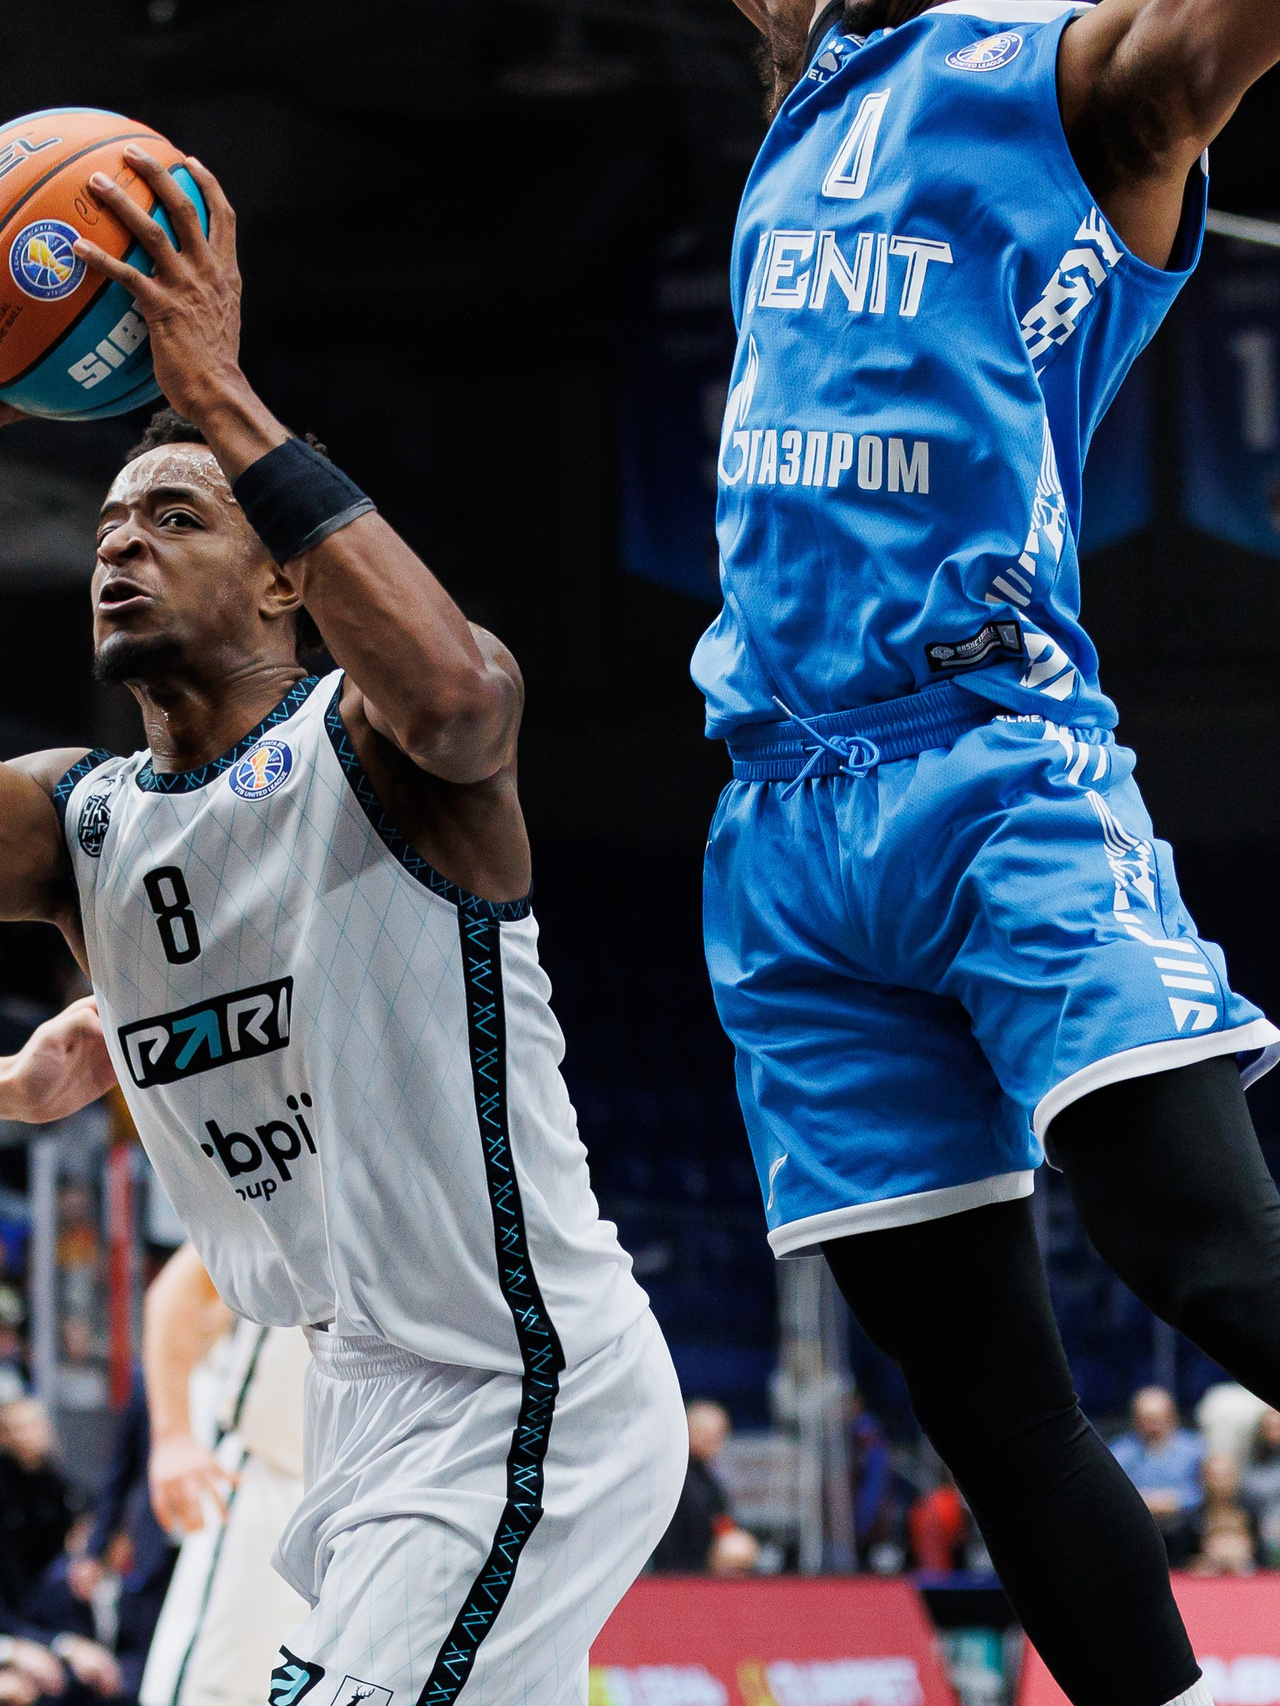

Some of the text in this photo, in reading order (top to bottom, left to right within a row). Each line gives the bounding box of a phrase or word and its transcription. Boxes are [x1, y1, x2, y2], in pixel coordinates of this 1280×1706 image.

[822, 88, 891, 200] 0
[67, 297, 150, 390] SIB
[747, 430, 930, 495] ГАЗПРОМ
[992, 714, 1041, 723] ELME
[244, 789, 269, 798] UNITED
[142, 865, 202, 966] 8
[125, 986, 289, 1082] PARI
[200, 1092, 318, 1182] bpi
